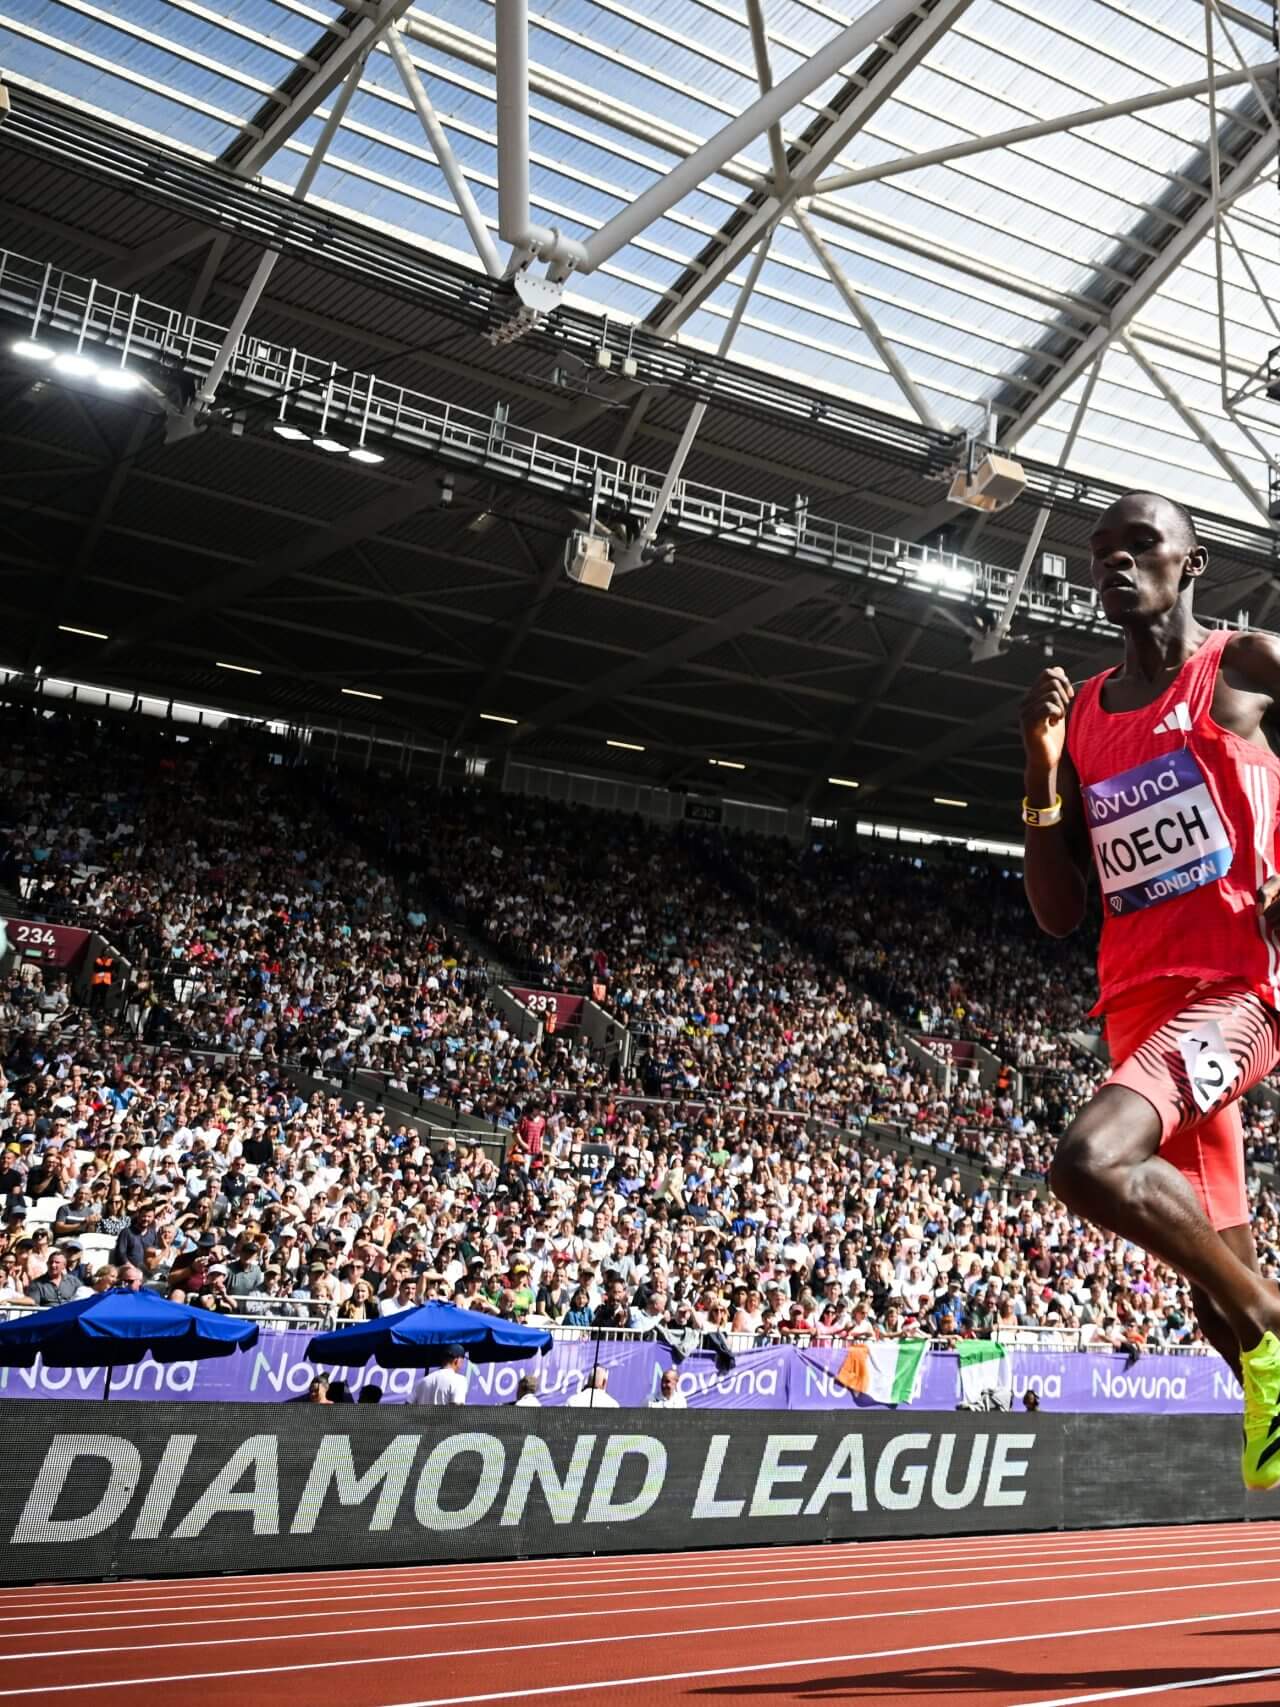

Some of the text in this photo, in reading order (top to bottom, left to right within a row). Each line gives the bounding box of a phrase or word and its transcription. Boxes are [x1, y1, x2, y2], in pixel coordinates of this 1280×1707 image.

[1097, 805, 1210, 879] KOECH
[1144, 860, 1217, 900] LONDON
[17, 926, 55, 945] 234
[1012, 1375, 1061, 1398] una
[1092, 1368, 1187, 1400] Novuna
[10, 1433, 1036, 1544] DIAMOND LEAGUE
